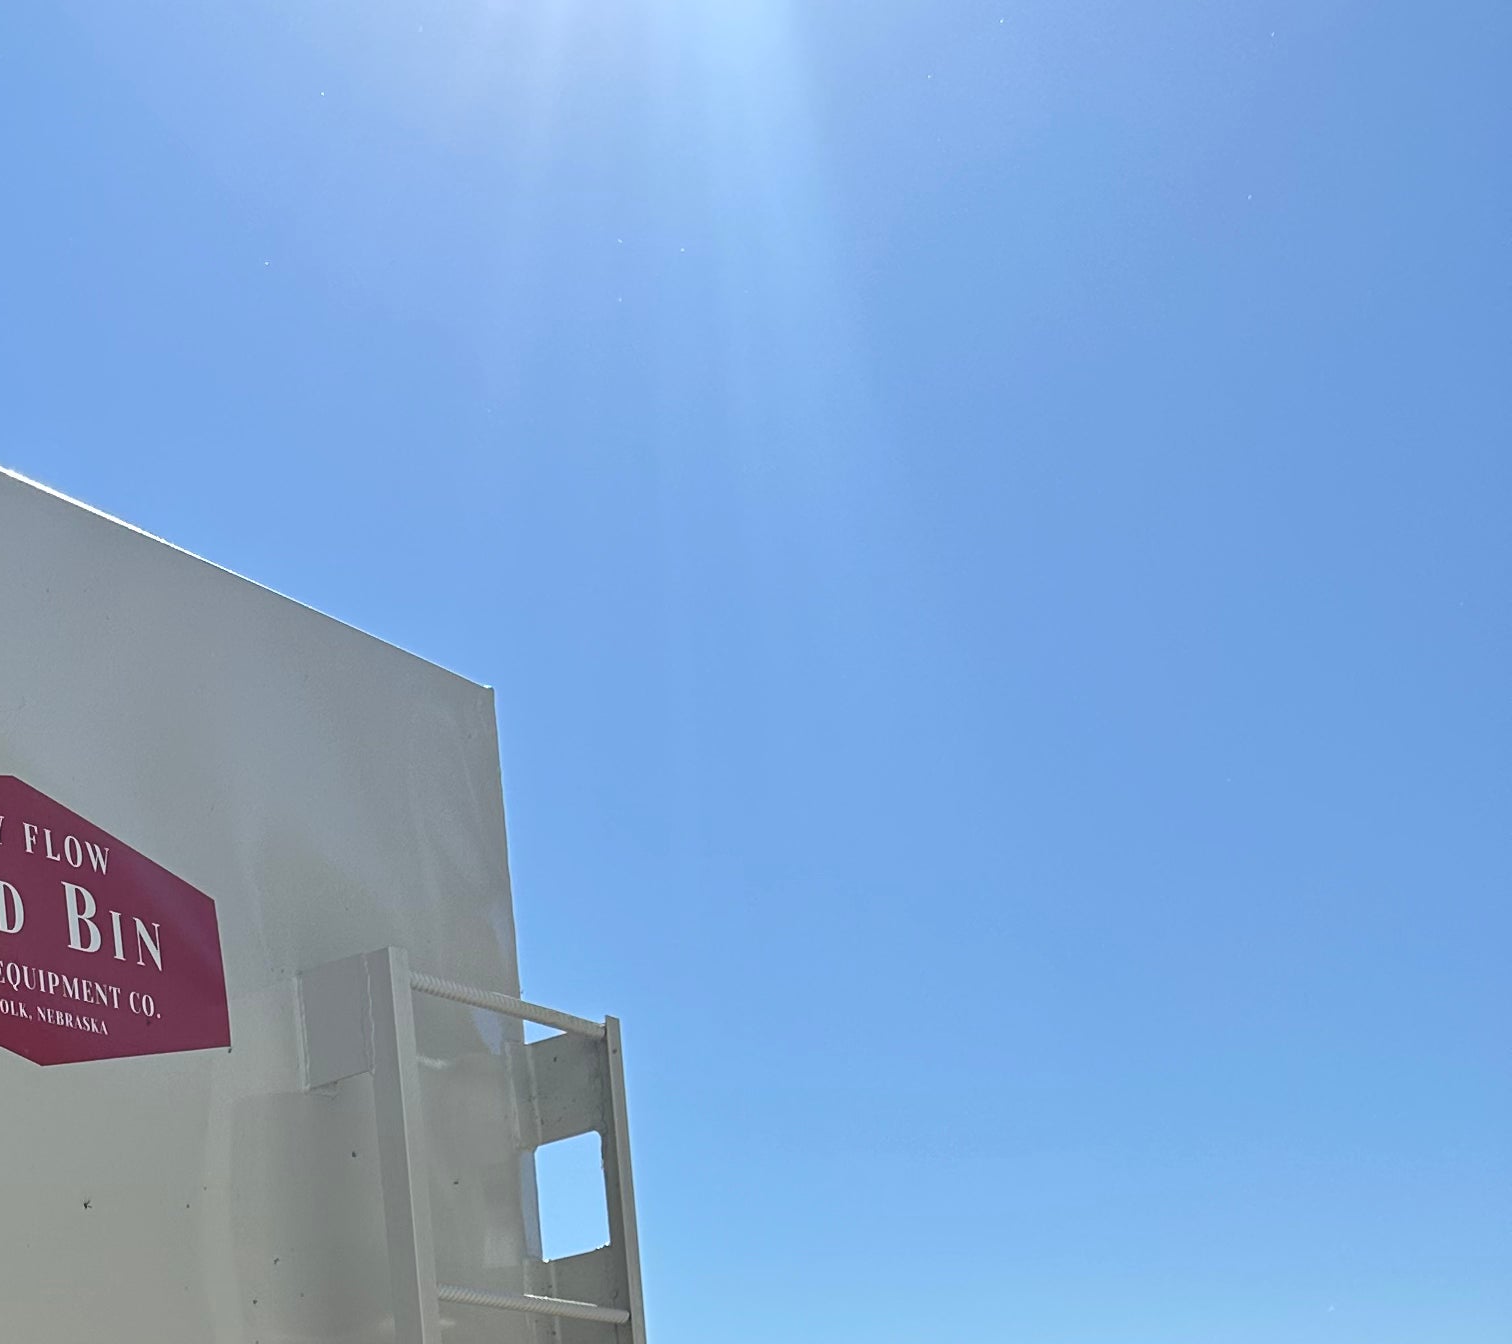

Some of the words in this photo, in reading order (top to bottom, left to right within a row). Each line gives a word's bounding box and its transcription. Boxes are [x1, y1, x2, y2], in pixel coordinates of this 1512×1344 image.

[22, 822, 110, 876] FLOW
[61, 881, 163, 973] BIN
[37, 1006, 109, 1036] NEBRASKA
[129, 991, 162, 1019] CO.
